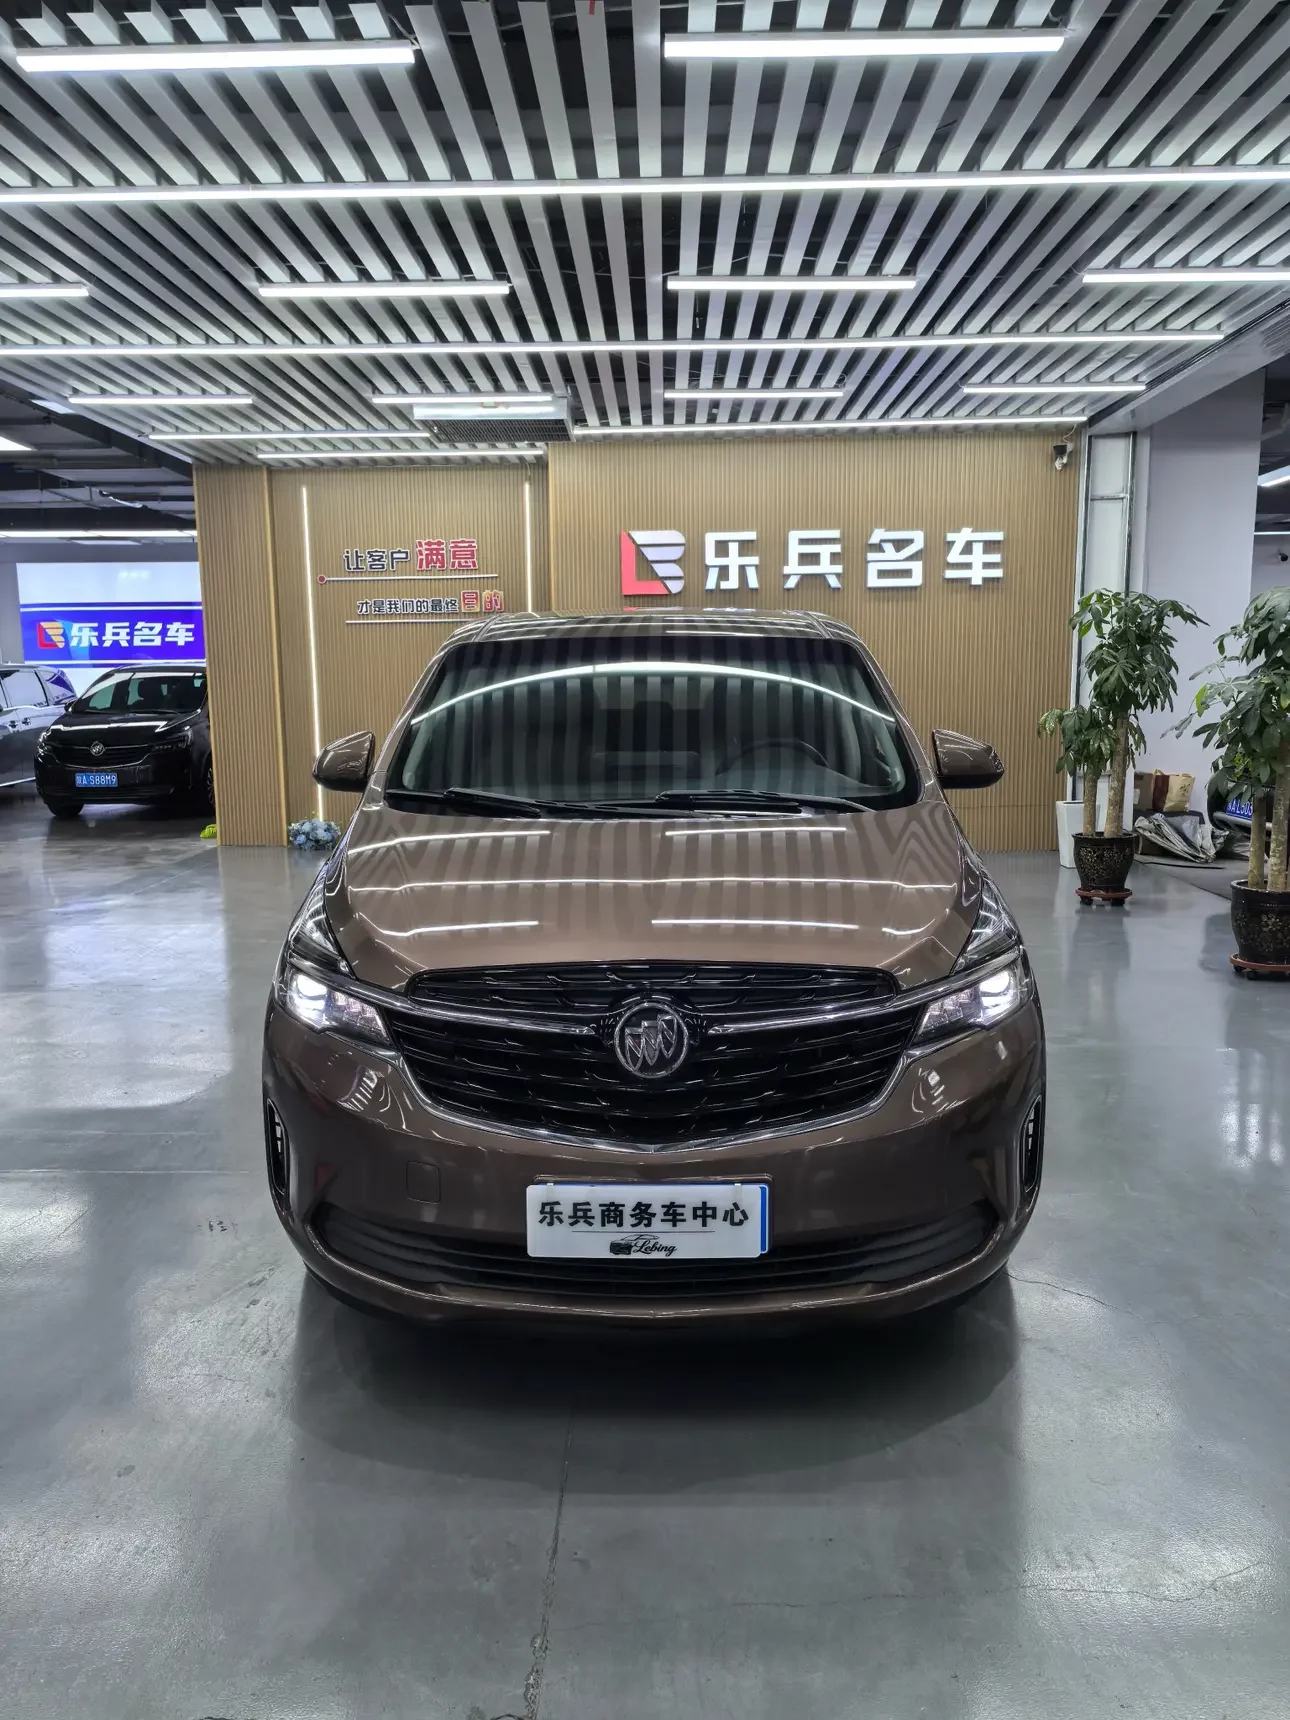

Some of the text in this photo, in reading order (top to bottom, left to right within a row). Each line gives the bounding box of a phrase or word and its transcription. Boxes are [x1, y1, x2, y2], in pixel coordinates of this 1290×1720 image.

[704, 527, 1004, 590] 乐兵名车
[69, 621, 195, 648] 乐兵名车
[538, 1201, 749, 1228] 乐兵商务车中心
[633, 1240, 677, 1257] Lebing
